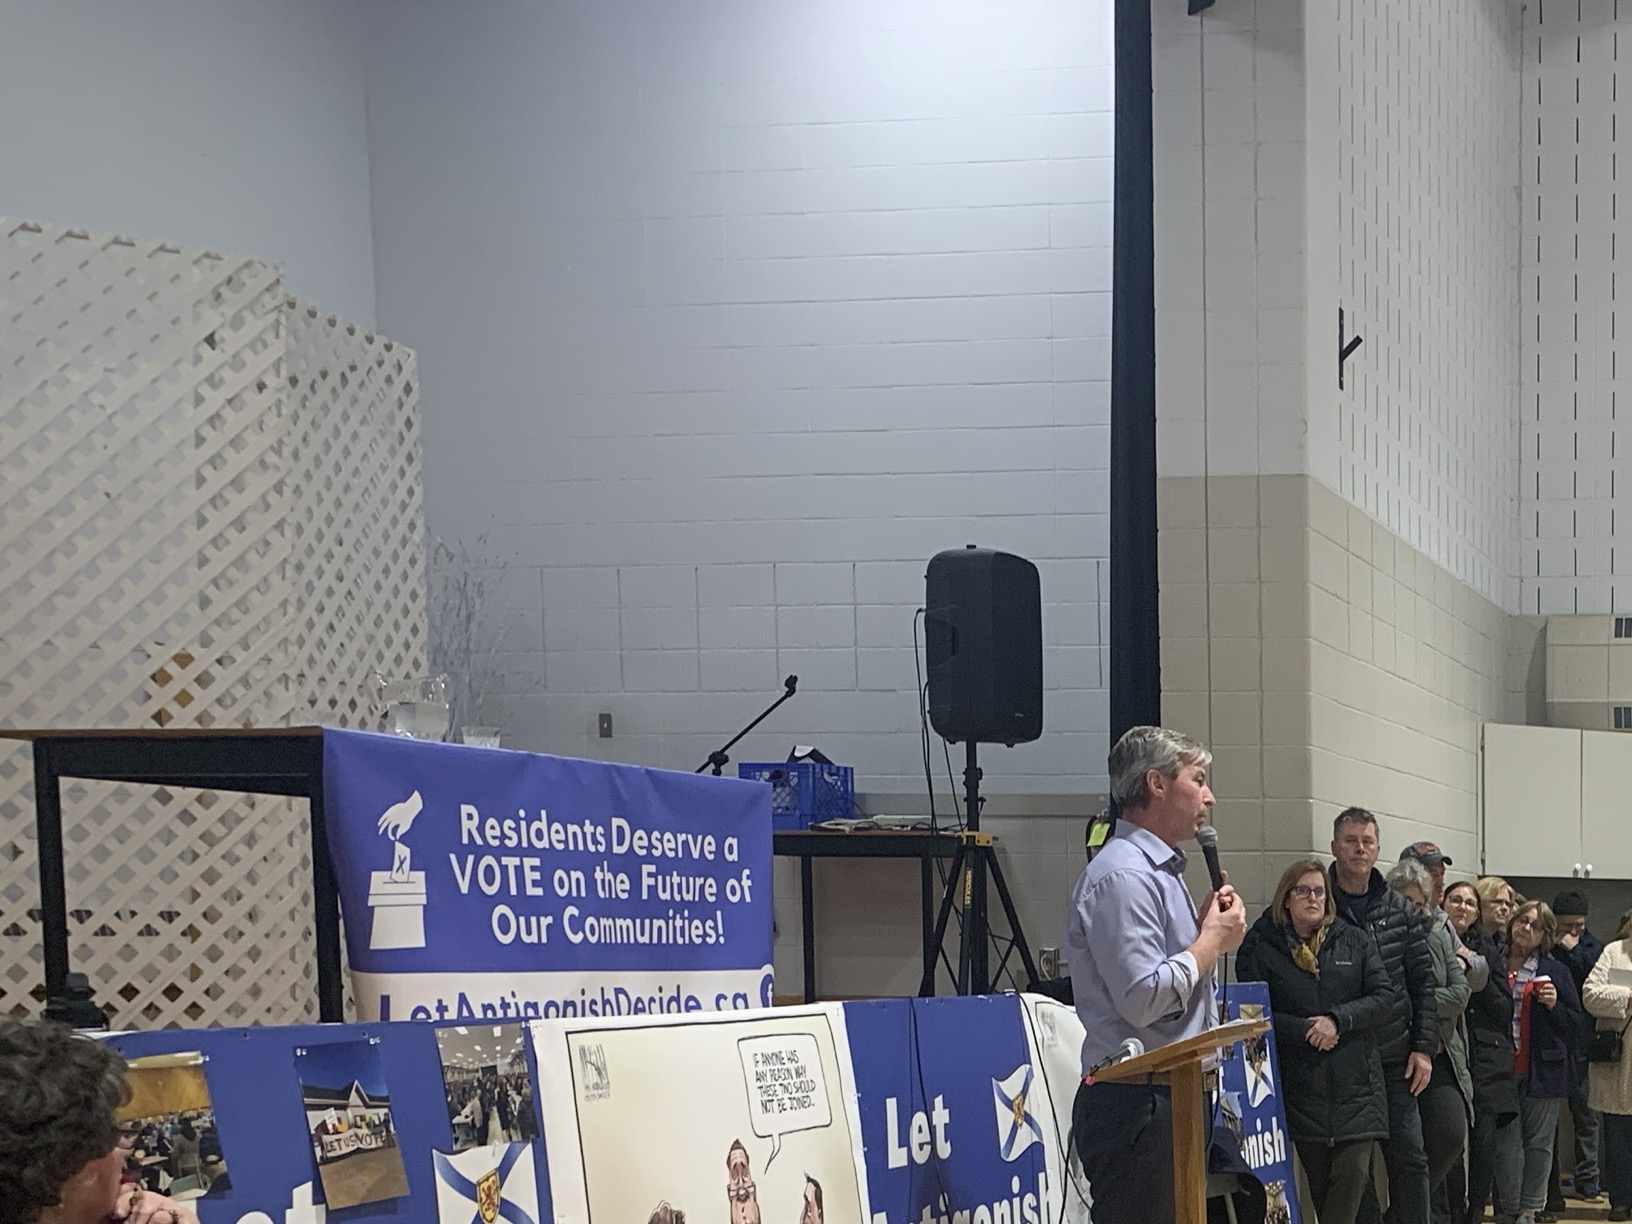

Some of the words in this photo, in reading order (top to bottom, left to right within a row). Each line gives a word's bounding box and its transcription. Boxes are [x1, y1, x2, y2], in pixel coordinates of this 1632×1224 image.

[460, 804, 606, 853] Residents
[611, 817, 716, 860] Deserve
[724, 836, 738, 862] a
[449, 853, 544, 896] VOTE
[553, 869, 586, 897] on
[594, 860, 630, 900] the
[641, 864, 717, 902] Future
[725, 868, 752, 903] of
[491, 904, 553, 945] Our
[563, 905, 724, 945] Communities!
[785, 1049, 799, 1064] HAS
[755, 1069, 767, 1083] ANY
[757, 1083, 779, 1098] THESE
[793, 1078, 816, 1094] SHOULD
[760, 1098, 774, 1115] NOT
[885, 1094, 951, 1170] Let
[325, 1139, 342, 1153] LET
[344, 1134, 356, 1148] US
